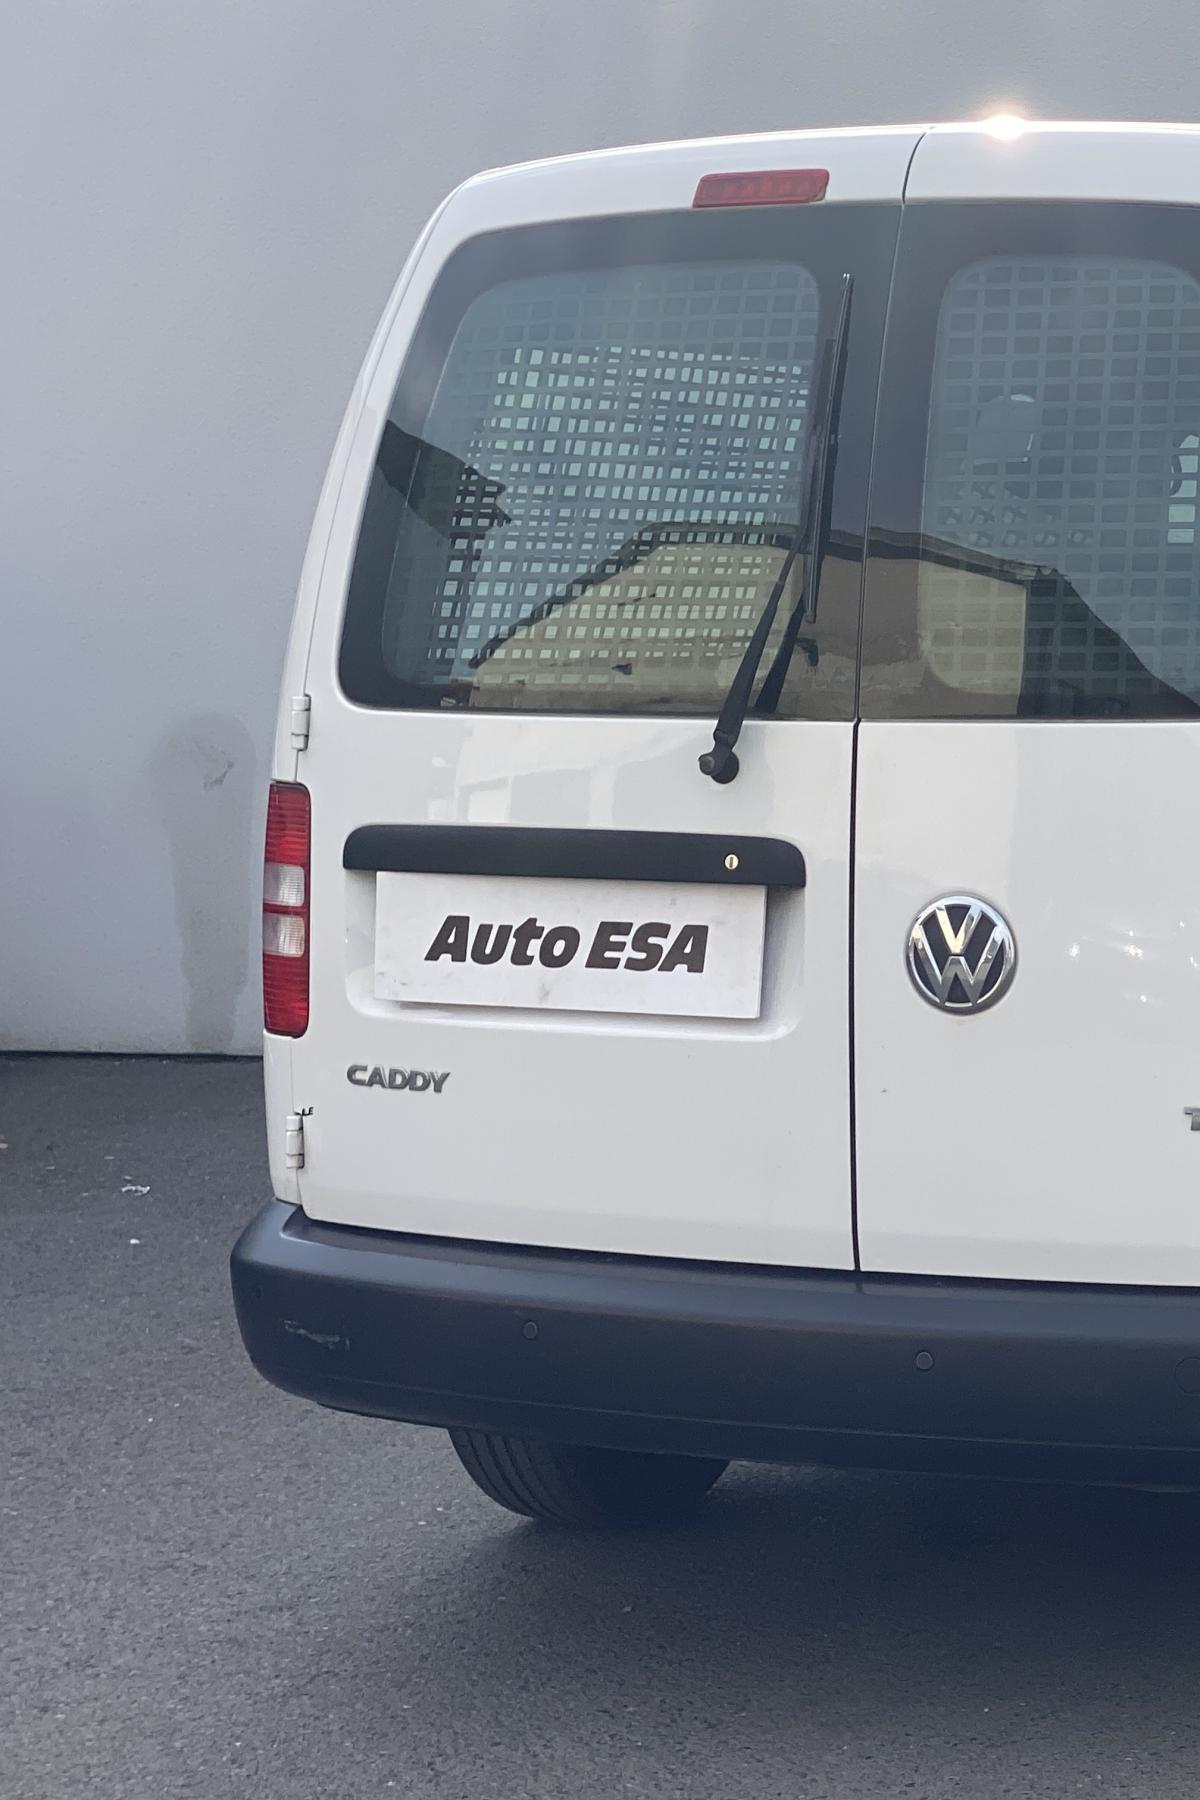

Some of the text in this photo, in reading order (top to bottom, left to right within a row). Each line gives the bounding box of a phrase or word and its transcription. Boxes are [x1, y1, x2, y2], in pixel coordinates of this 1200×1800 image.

[424, 914, 709, 973] Auto ESA
[346, 1064, 450, 1093] CADDY
